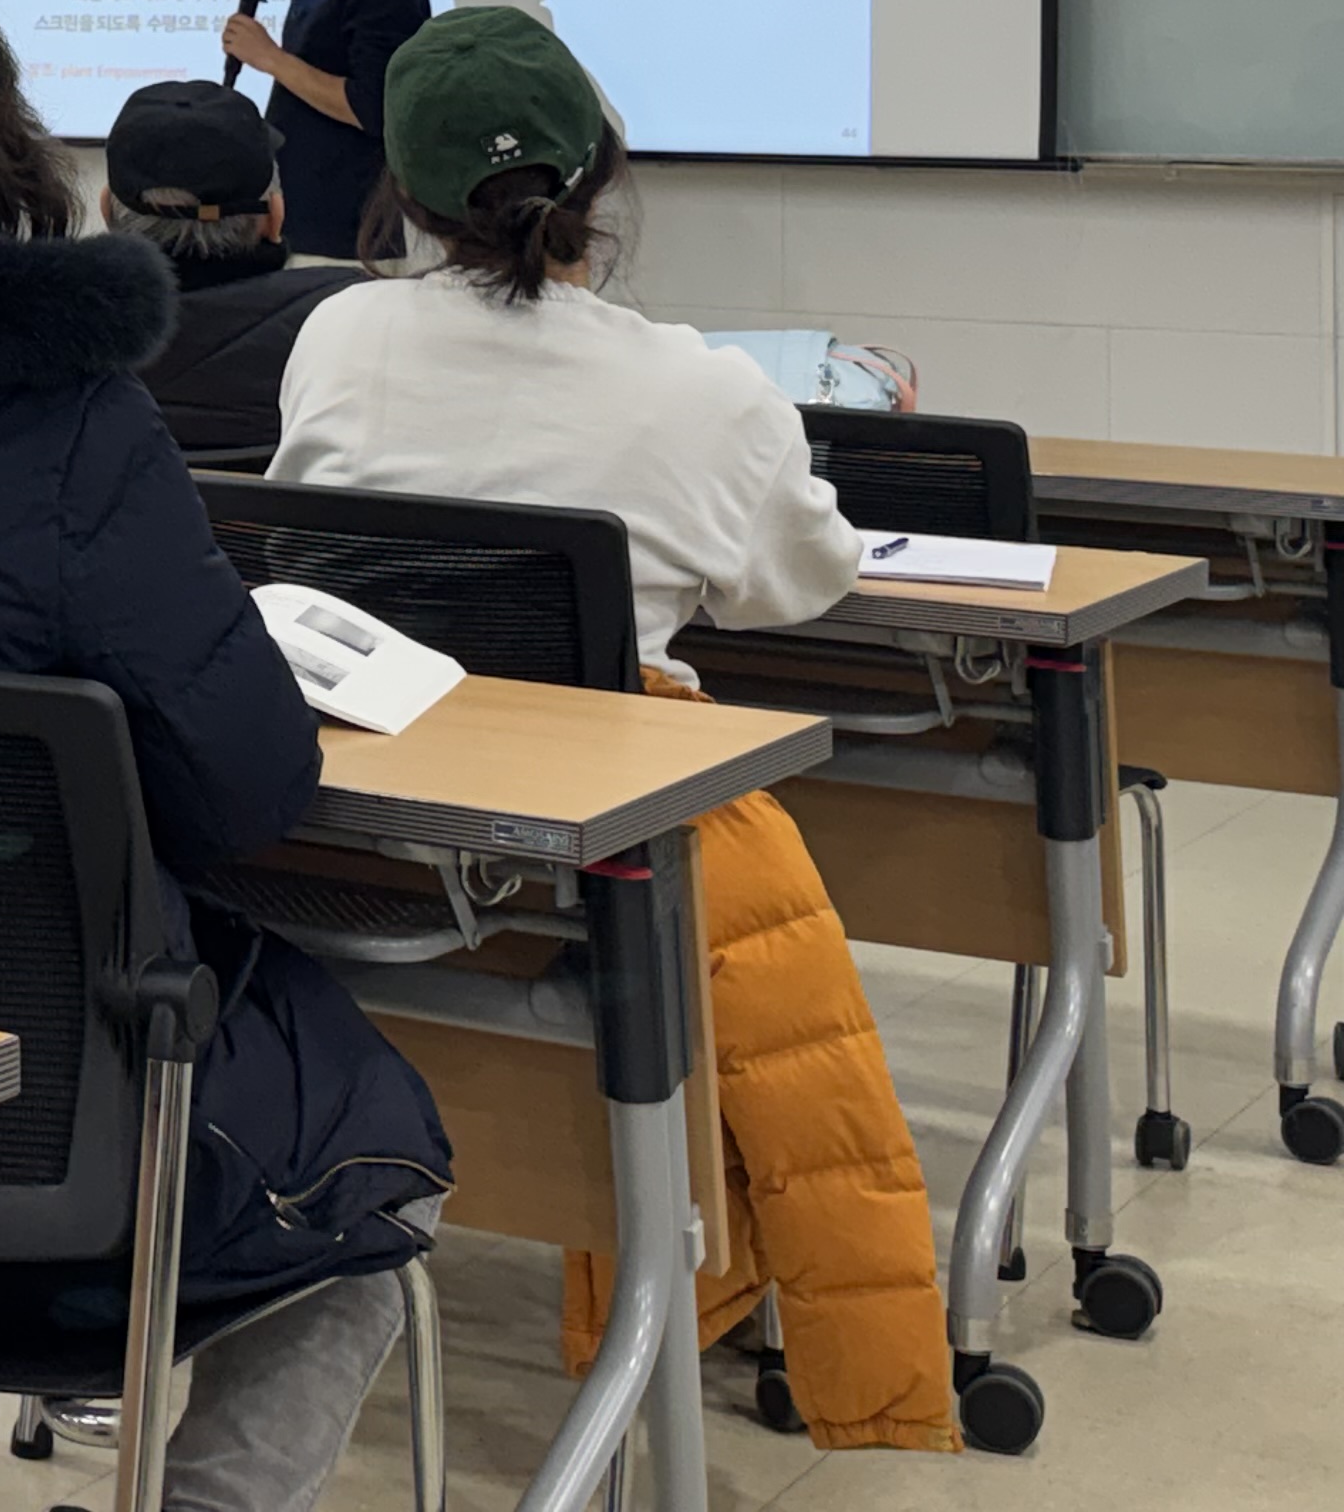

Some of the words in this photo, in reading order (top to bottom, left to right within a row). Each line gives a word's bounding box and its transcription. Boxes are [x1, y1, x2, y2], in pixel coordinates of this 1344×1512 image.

[34, 14, 95, 33] 스크린을
[97, 13, 141, 33] 되도록
[146, 14, 210, 33] 수평으로
